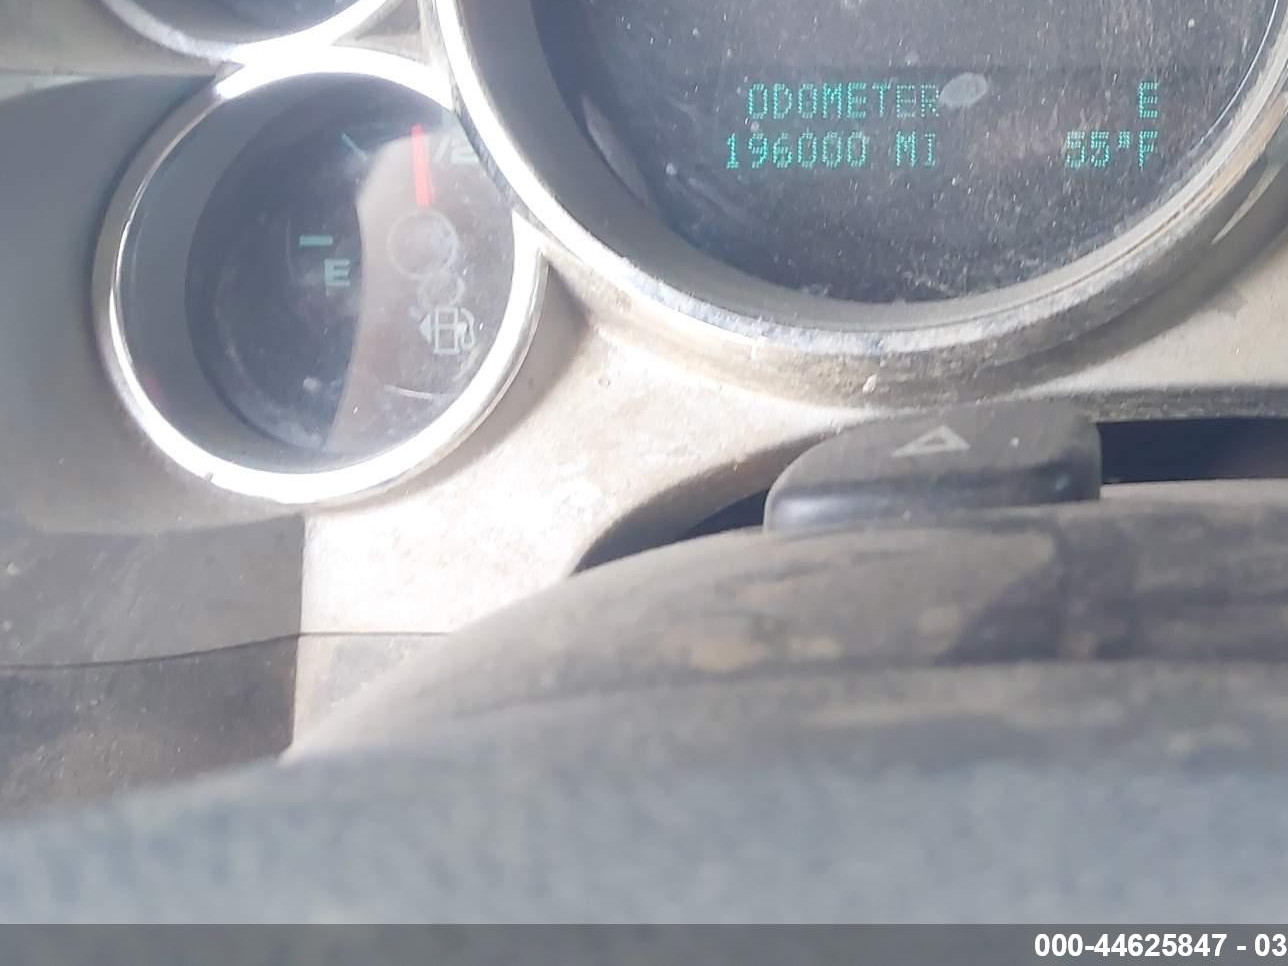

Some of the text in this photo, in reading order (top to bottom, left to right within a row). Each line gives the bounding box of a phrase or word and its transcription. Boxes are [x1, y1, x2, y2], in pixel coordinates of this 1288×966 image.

[748, 81, 1159, 120] ODOMETER E
[726, 132, 866, 170] 196000
[895, 131, 937, 169] MI
[324, 259, 351, 287] E
